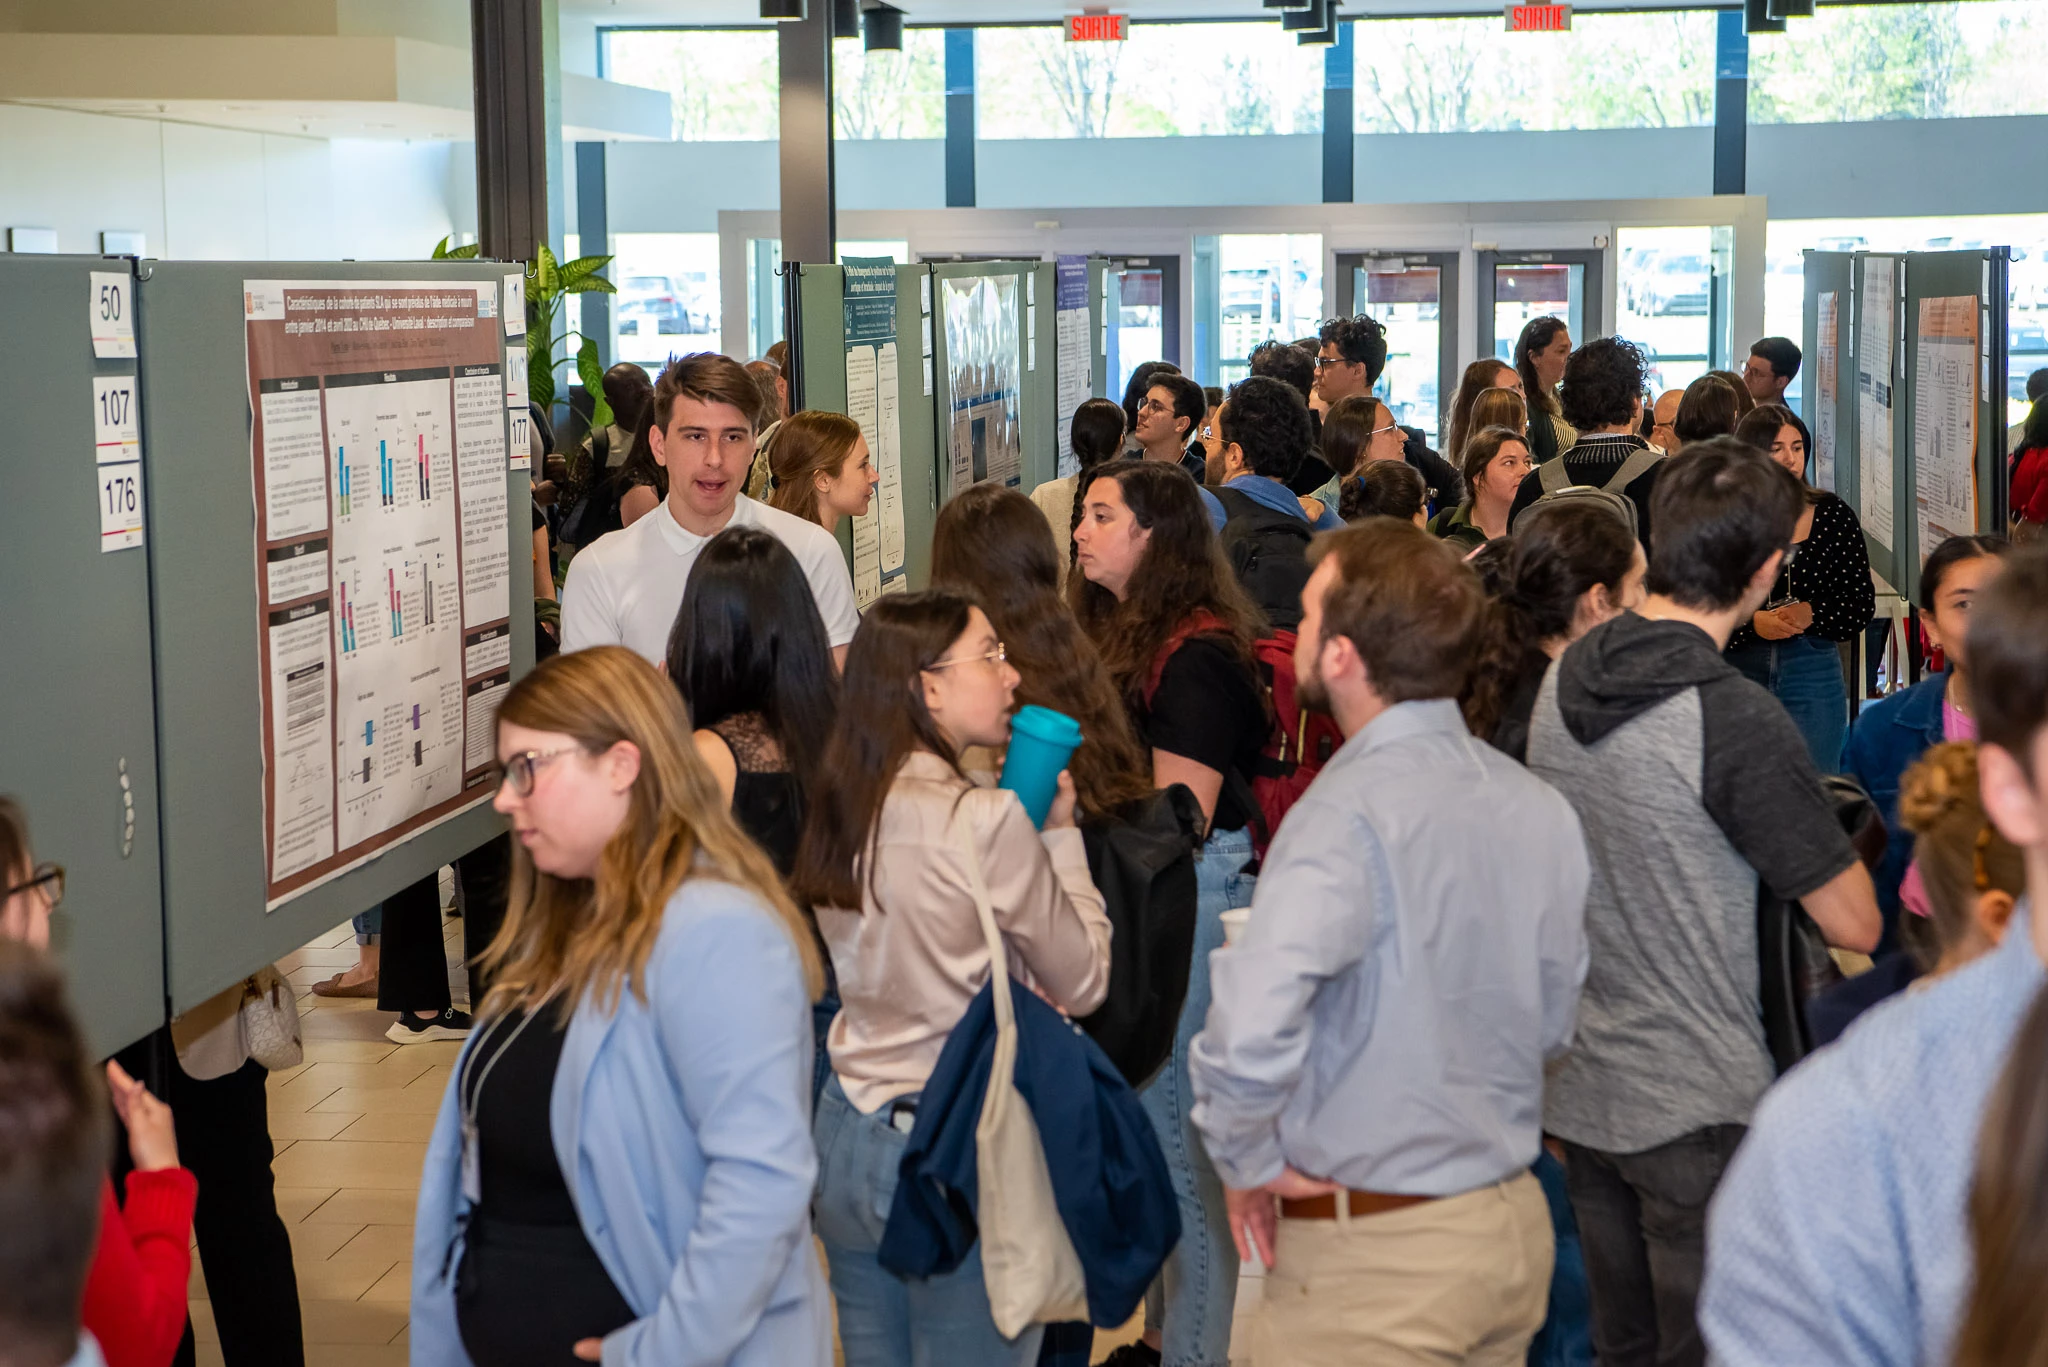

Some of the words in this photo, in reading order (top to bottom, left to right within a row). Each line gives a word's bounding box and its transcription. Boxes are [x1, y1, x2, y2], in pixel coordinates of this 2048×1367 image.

[1072, 15, 1122, 41] SORTIE
[1513, 5, 1566, 31] SORTIE
[101, 285, 120, 321] 50
[101, 390, 129, 425] 107
[513, 419, 526, 444] 177
[106, 477, 135, 514] 176
